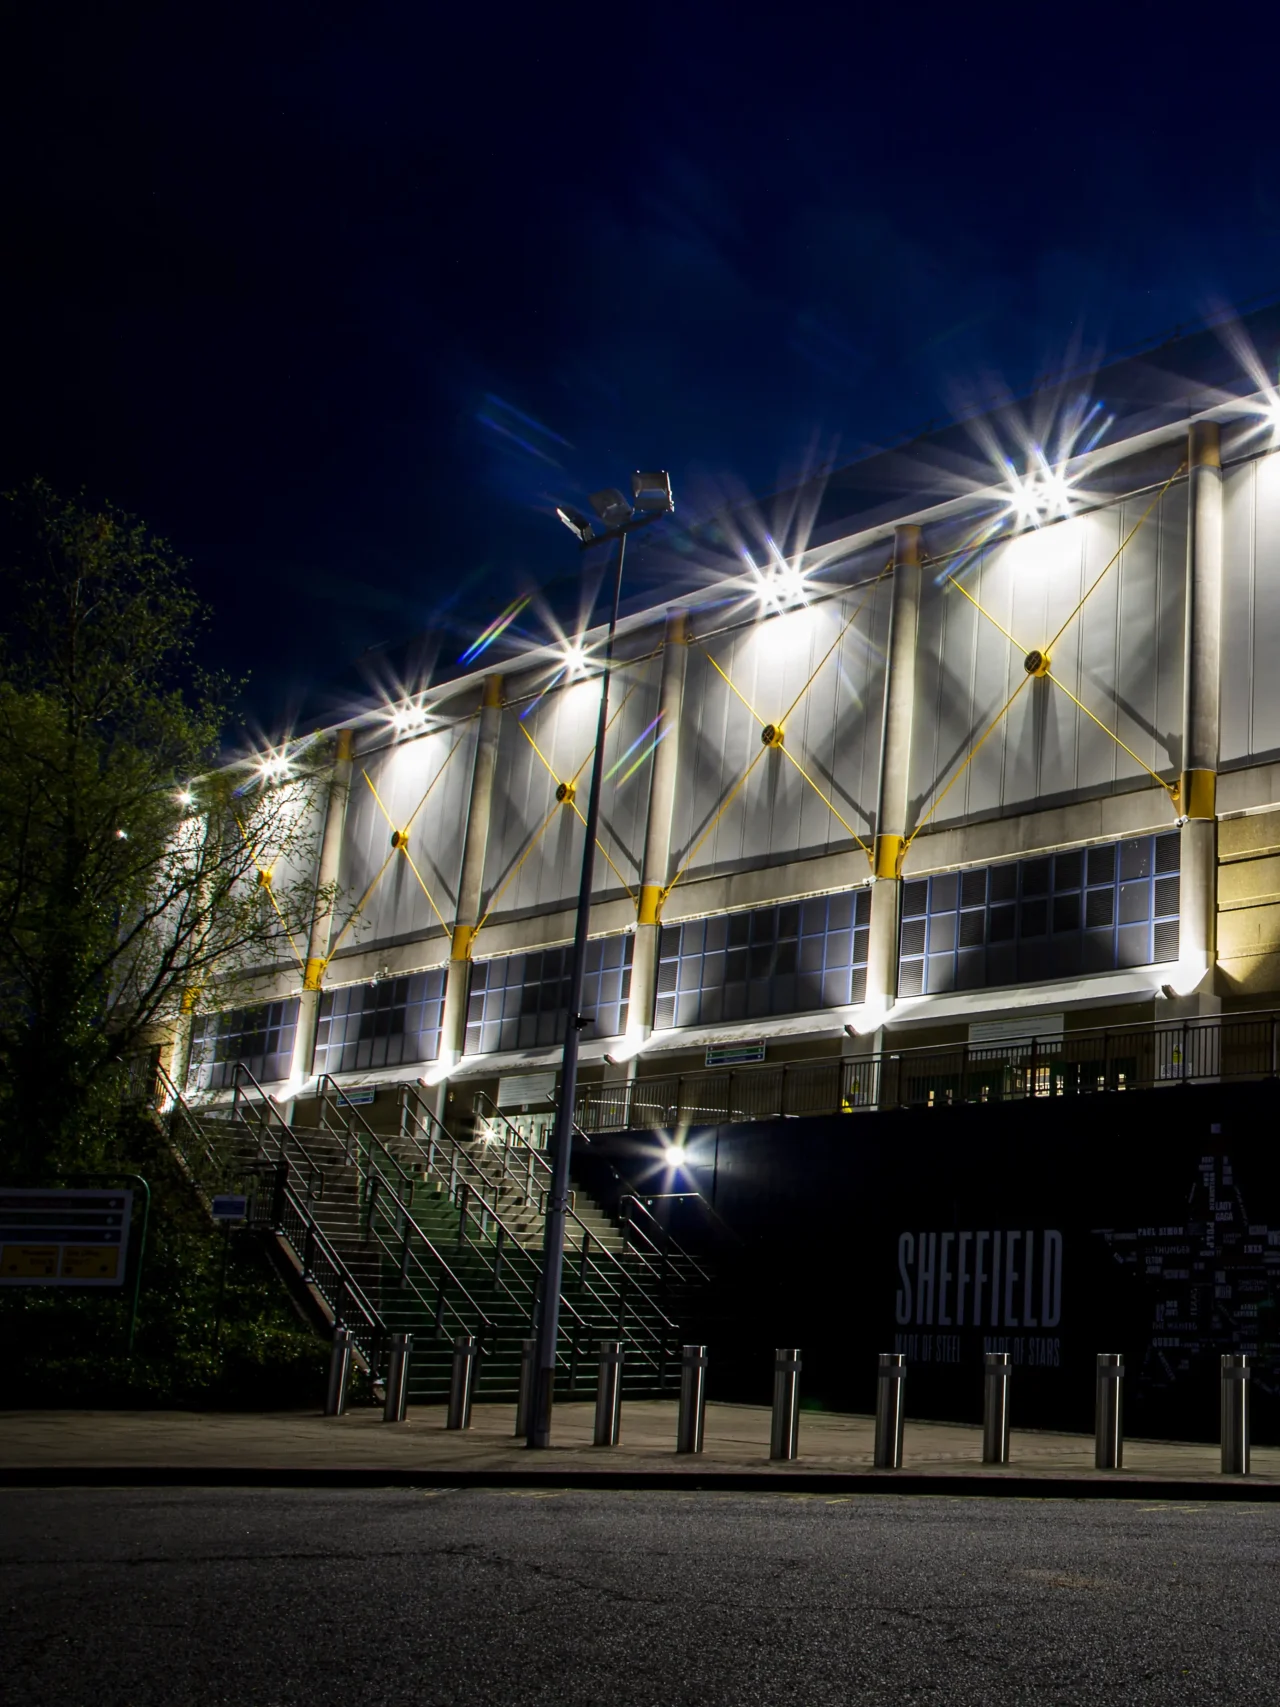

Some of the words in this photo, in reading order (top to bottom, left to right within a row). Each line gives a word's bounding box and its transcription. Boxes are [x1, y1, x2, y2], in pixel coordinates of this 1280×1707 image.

[1215, 1201, 1232, 1211] LADY
[1215, 1211, 1233, 1222] GAGA
[1137, 1227, 1157, 1236] PAUL
[1158, 1226, 1184, 1236] SIMON
[1206, 1221, 1215, 1249] PULP
[1145, 1256, 1163, 1265] ELTON
[895, 1229, 1063, 1328] SHEFFIELD
[895, 1333, 919, 1362] MADE
[922, 1334, 933, 1362] OF
[936, 1334, 961, 1363] STEEL
[1013, 1336, 1025, 1366] OF
[1028, 1337, 1061, 1368] STARS
